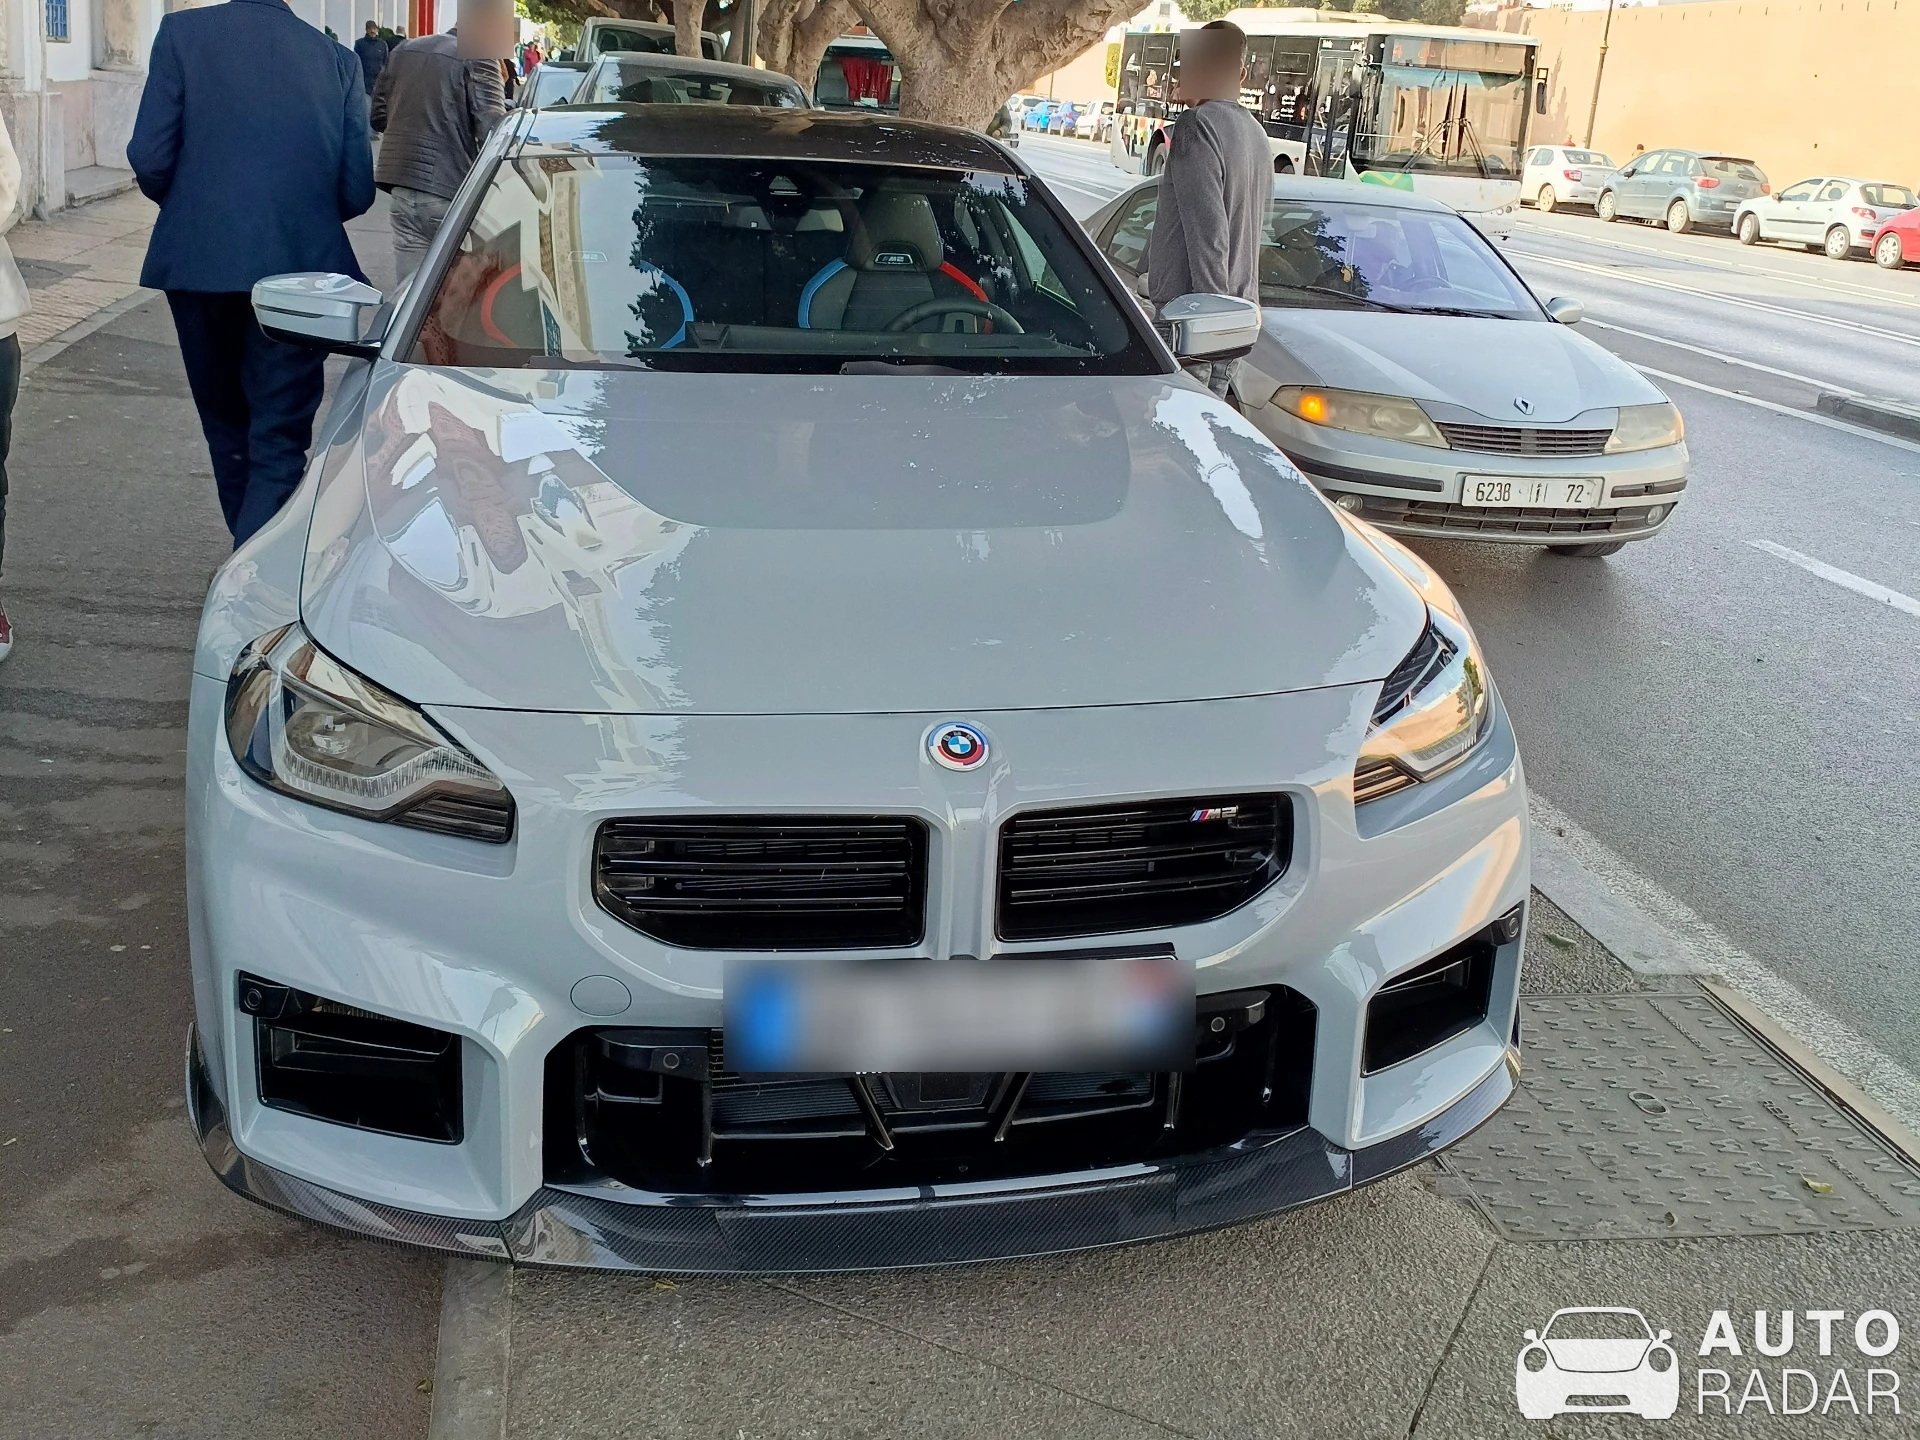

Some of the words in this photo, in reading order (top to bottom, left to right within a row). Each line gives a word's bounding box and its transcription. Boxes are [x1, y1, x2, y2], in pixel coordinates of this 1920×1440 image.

[1475, 482, 1511, 502] 6238
[1566, 484, 1585, 503] 72
[942, 730, 974, 742] BMW
[1202, 806, 1237, 821] M2
